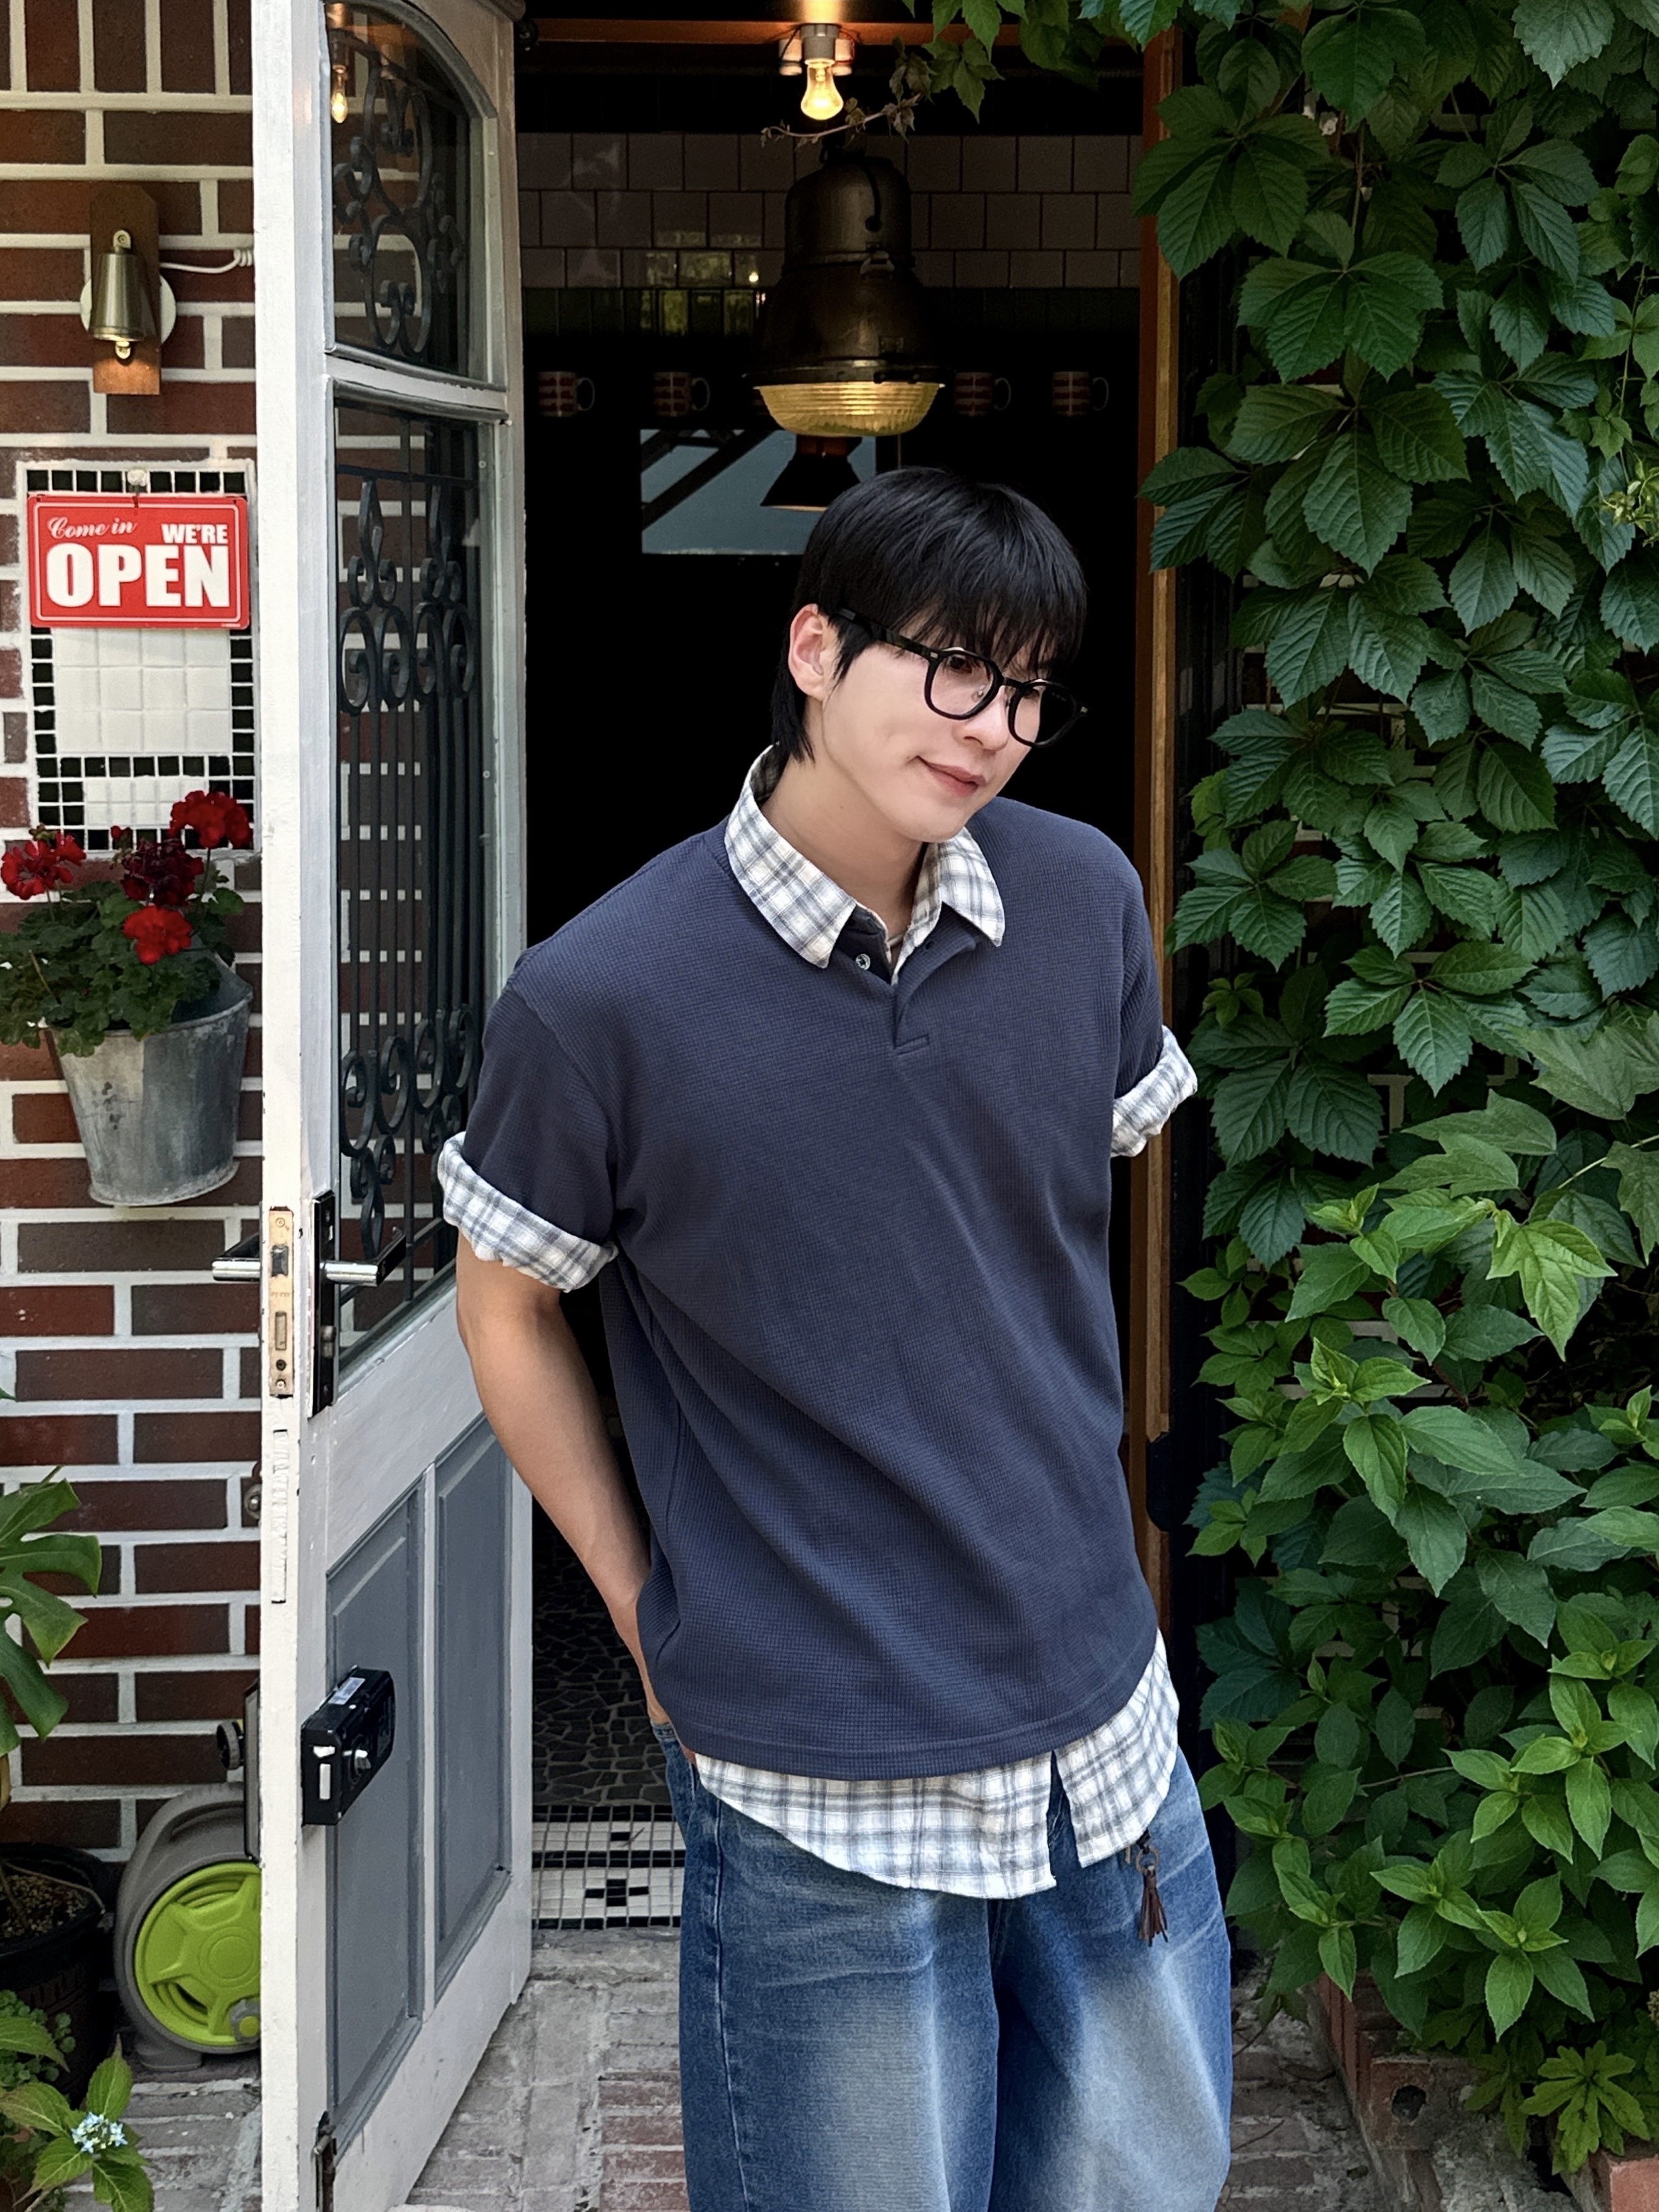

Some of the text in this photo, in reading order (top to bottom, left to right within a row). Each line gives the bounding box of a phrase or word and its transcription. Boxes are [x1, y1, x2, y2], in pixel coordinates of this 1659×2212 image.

[48, 516, 136, 538] Come in
[162, 524, 229, 544] WE'RE
[47, 543, 230, 607] OPEN
